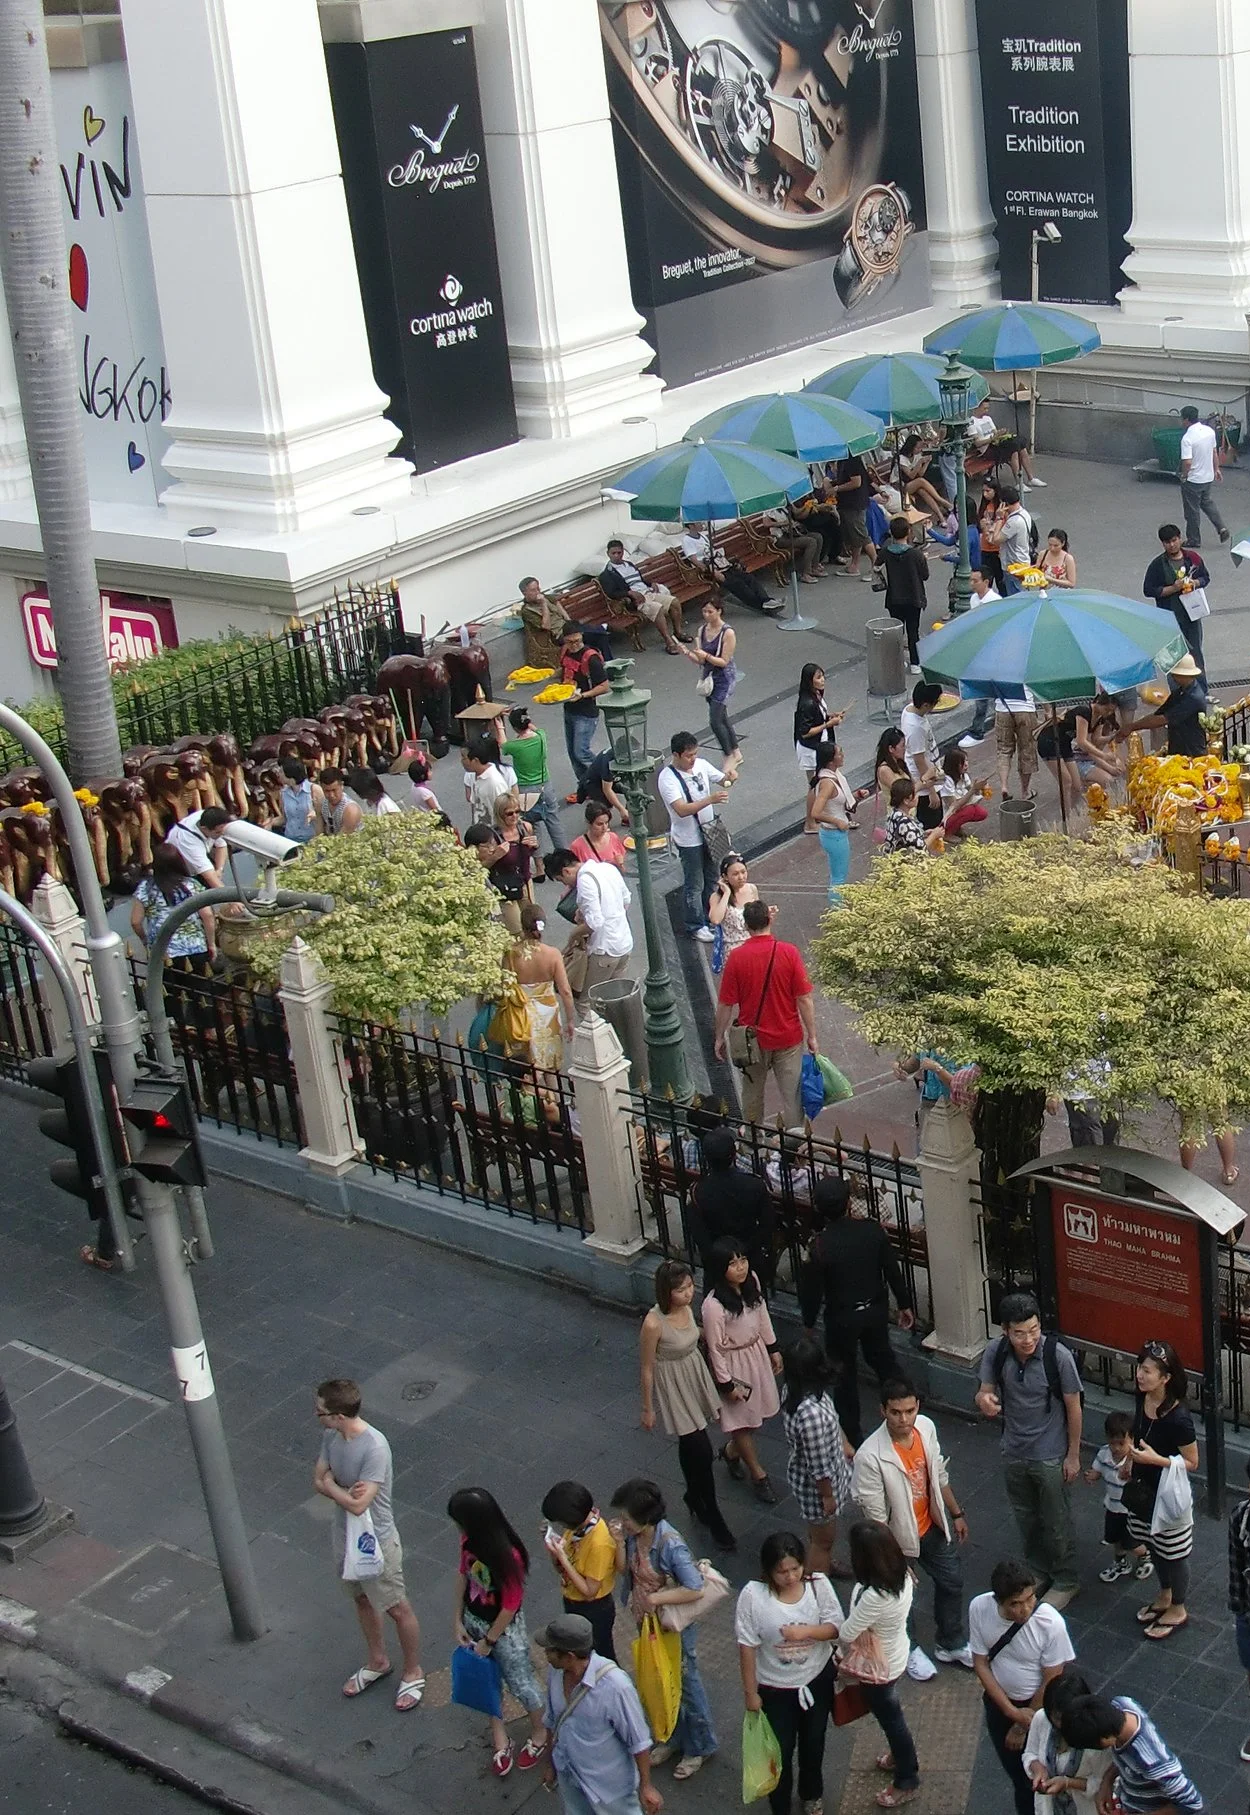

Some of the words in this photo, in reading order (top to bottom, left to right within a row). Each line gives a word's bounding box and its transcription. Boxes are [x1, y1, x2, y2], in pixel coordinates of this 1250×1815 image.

[837, 24, 902, 62] Breguet
[1010, 56, 1075, 72] 系列腕表展
[1008, 105, 1079, 125] Tradition
[1006, 134, 1085, 154] Exhibition
[60, 116, 132, 221] VIN
[388, 148, 480, 193] Breguet
[1006, 190, 1054, 203] CORTINA
[1055, 191, 1094, 204] WATCH
[1004, 205, 1015, 215] 1st
[1016, 206, 1026, 216] Fl.
[1028, 207, 1060, 217] Erawan
[1062, 208, 1099, 220] Bangkok
[694, 256, 707, 270] the
[702, 266, 723, 278] Tradition
[410, 311, 456, 335] cortina
[456, 298, 493, 323] watch
[1102, 1213, 1181, 1245] ท้าวมหาพรหม
[1104, 1238, 1122, 1248] THAO
[1126, 1243, 1146, 1255] MAHA
[1151, 1250, 1181, 1263] BRAHMA
